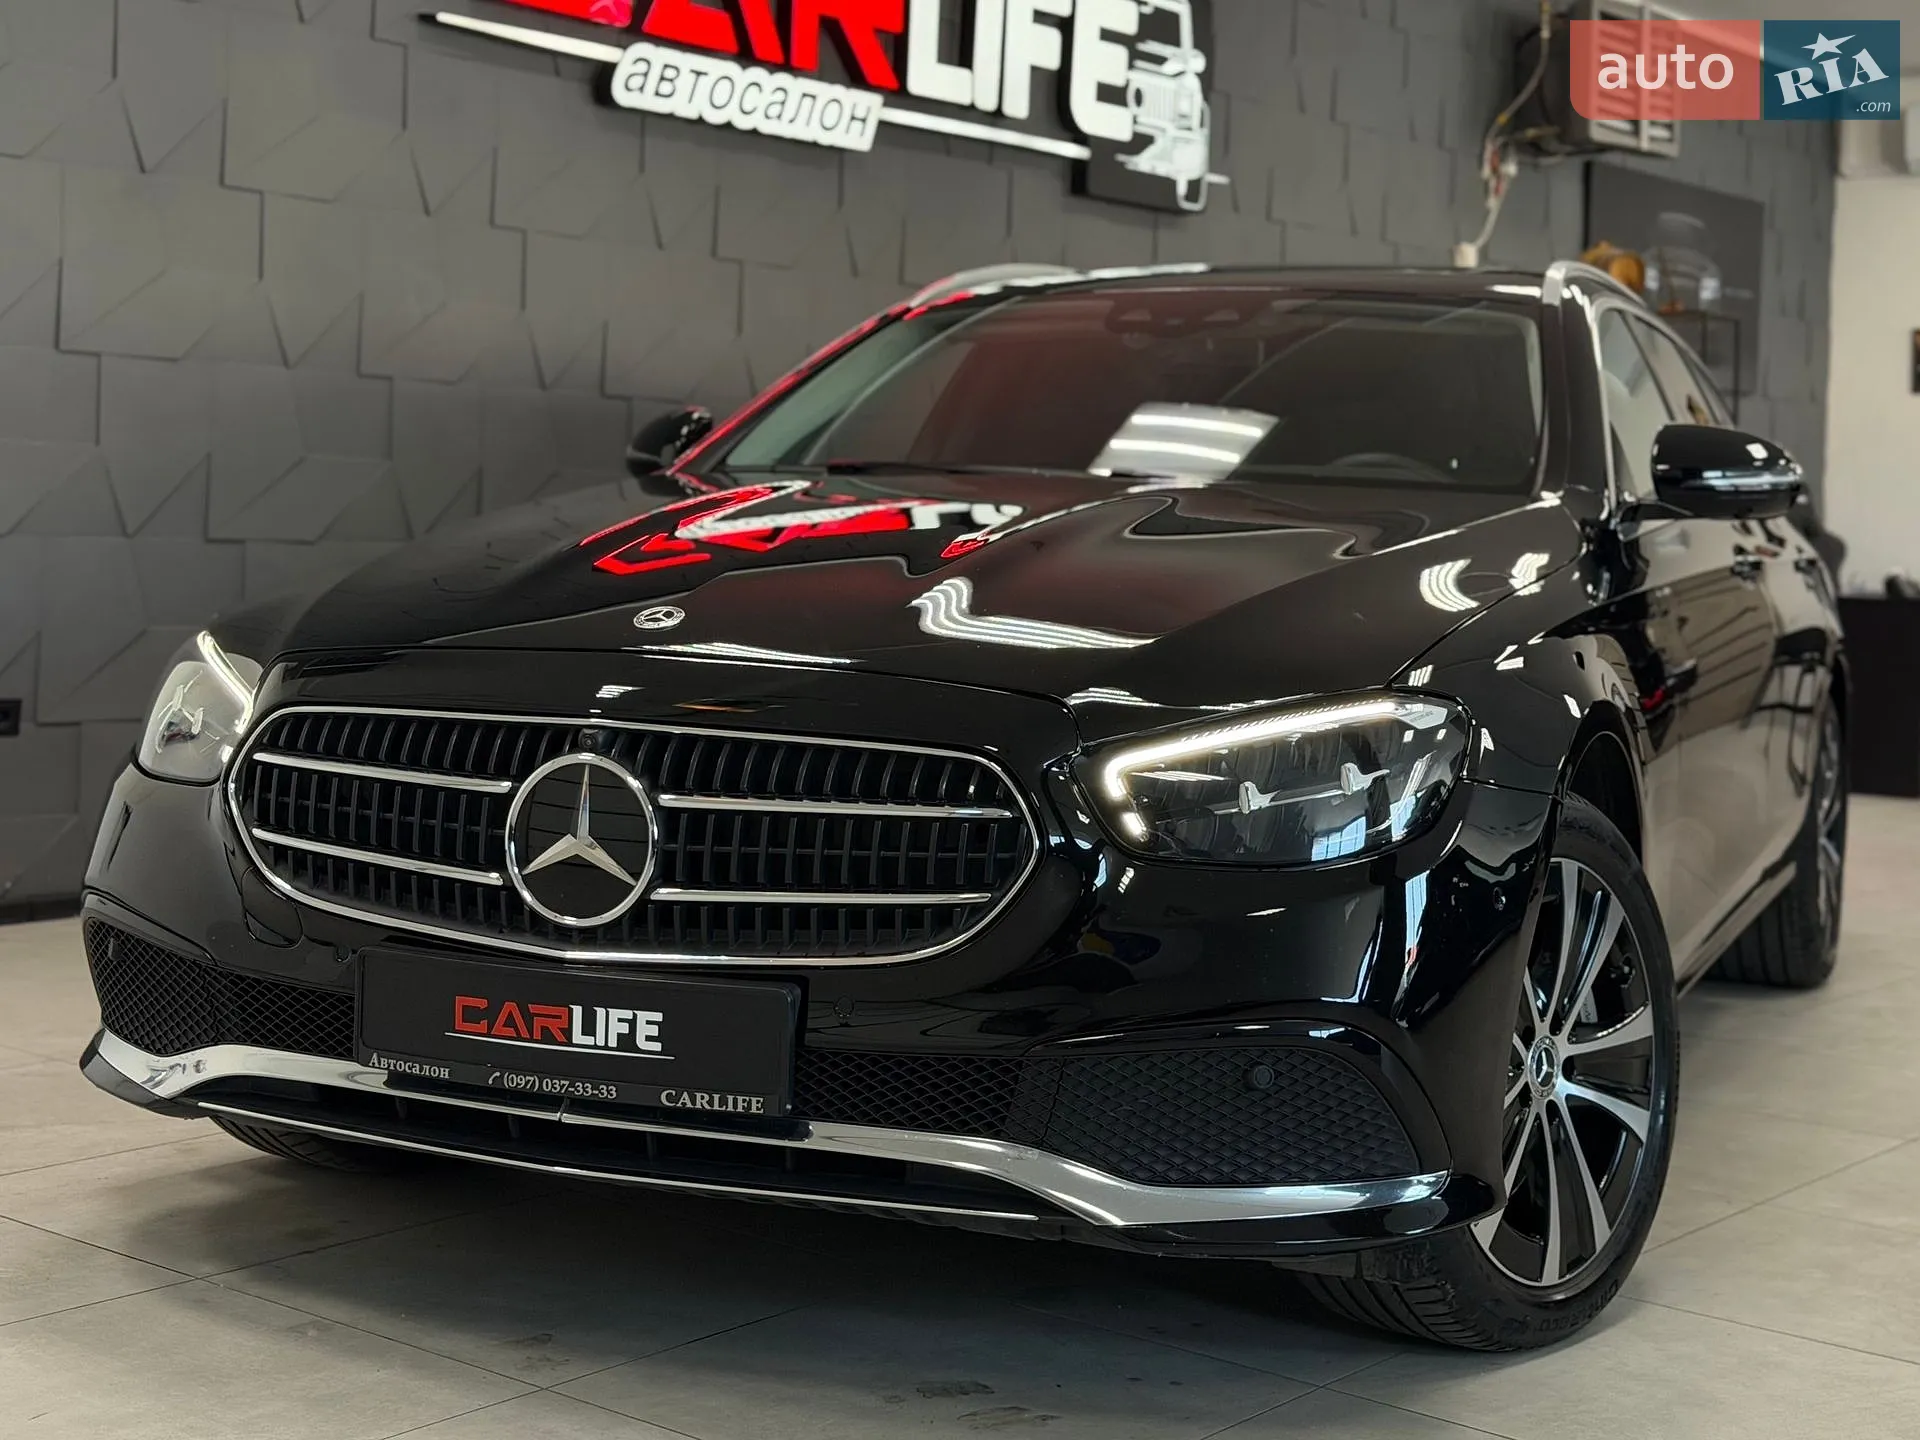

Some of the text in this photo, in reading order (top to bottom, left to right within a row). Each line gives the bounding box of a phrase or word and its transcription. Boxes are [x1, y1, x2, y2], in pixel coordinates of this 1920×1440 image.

[506, 0, 1139, 141] RLIFE
[624, 57, 873, 138] автосалон
[455, 995, 663, 1052] CARLIFE
[368, 1052, 450, 1079] Автосалон
[503, 1072, 617, 1099] (097) 037-33-33
[660, 1089, 764, 1114] CARLIFE
